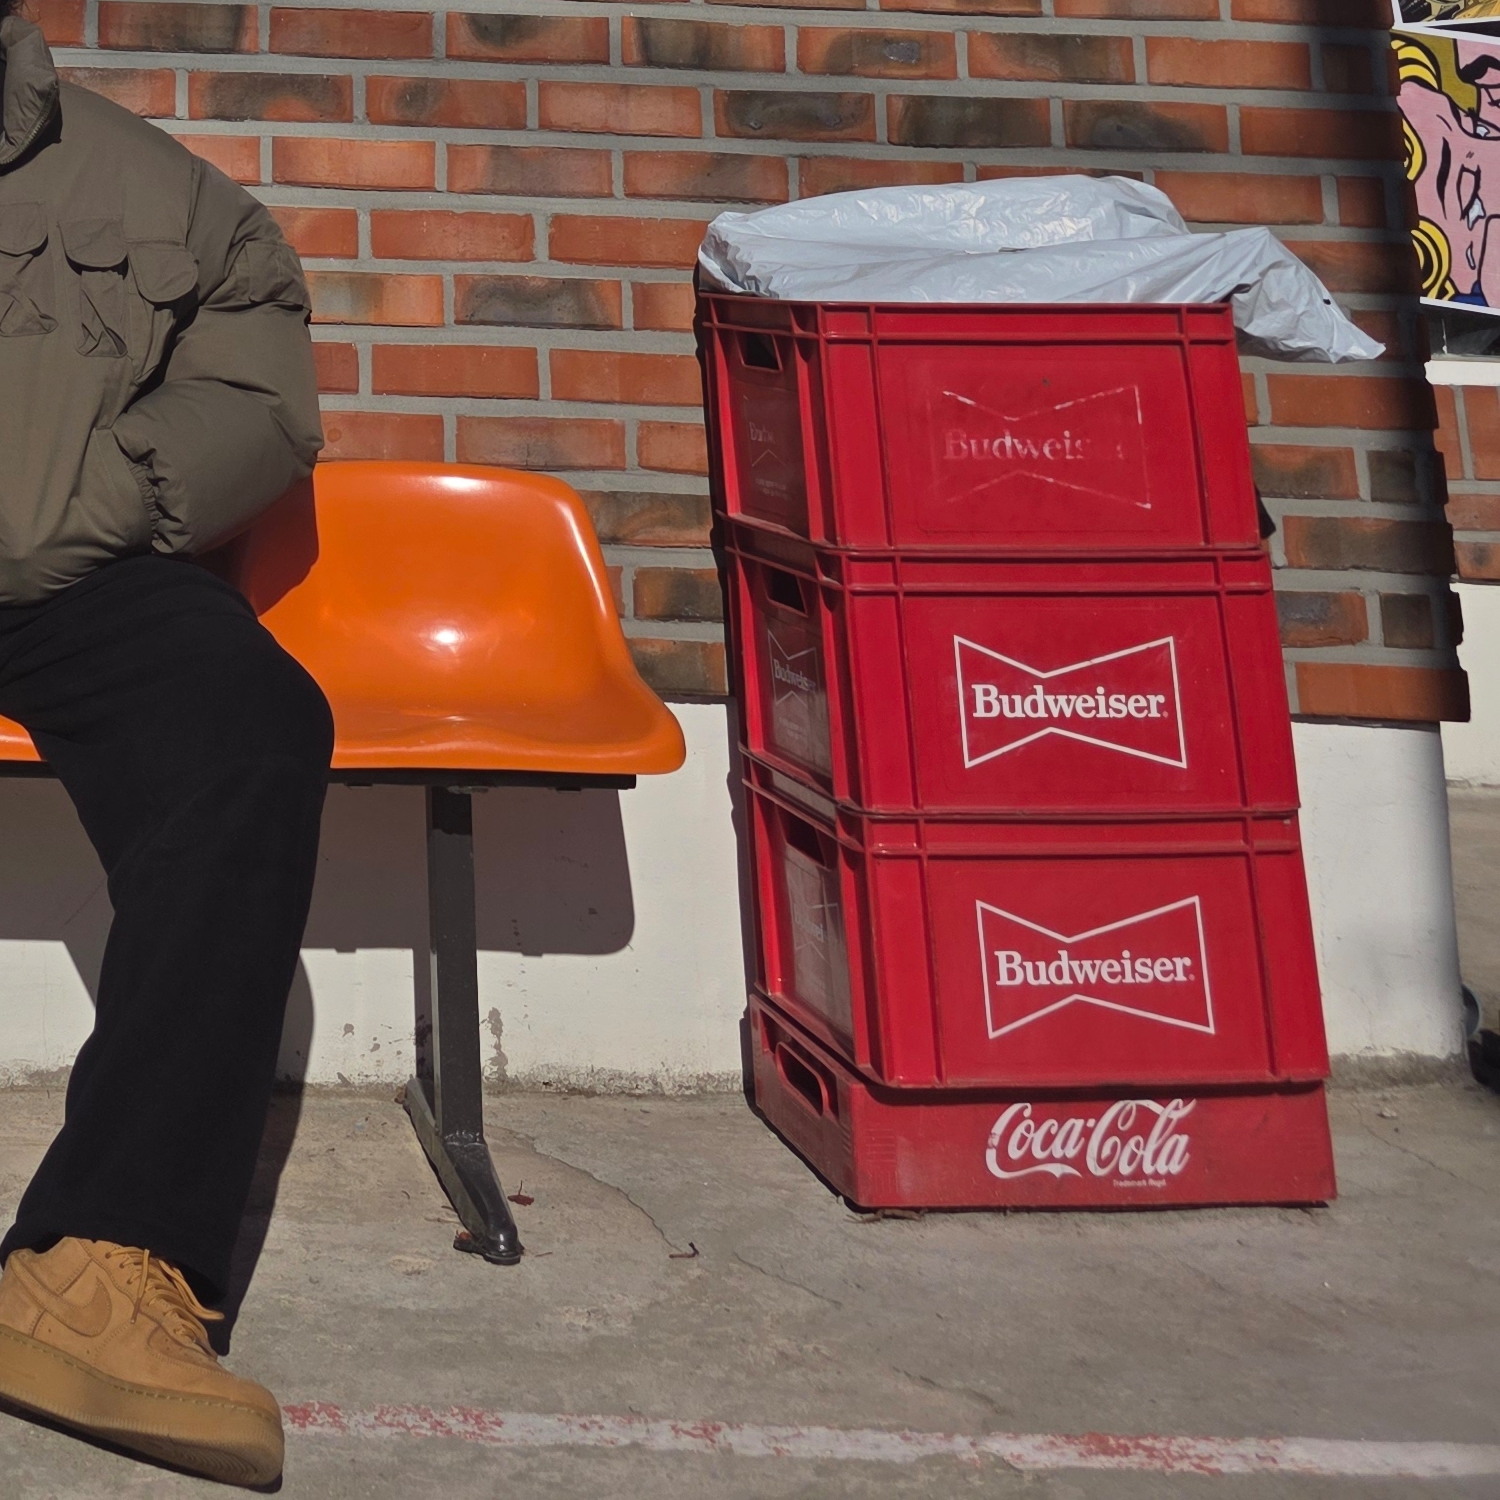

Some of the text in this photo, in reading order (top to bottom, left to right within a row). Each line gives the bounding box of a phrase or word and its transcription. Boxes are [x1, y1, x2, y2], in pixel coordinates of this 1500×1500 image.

[971, 684, 1165, 718] Budweiser
[994, 950, 1192, 986] Budweiser
[986, 1098, 1197, 1179] Coca-Cola
